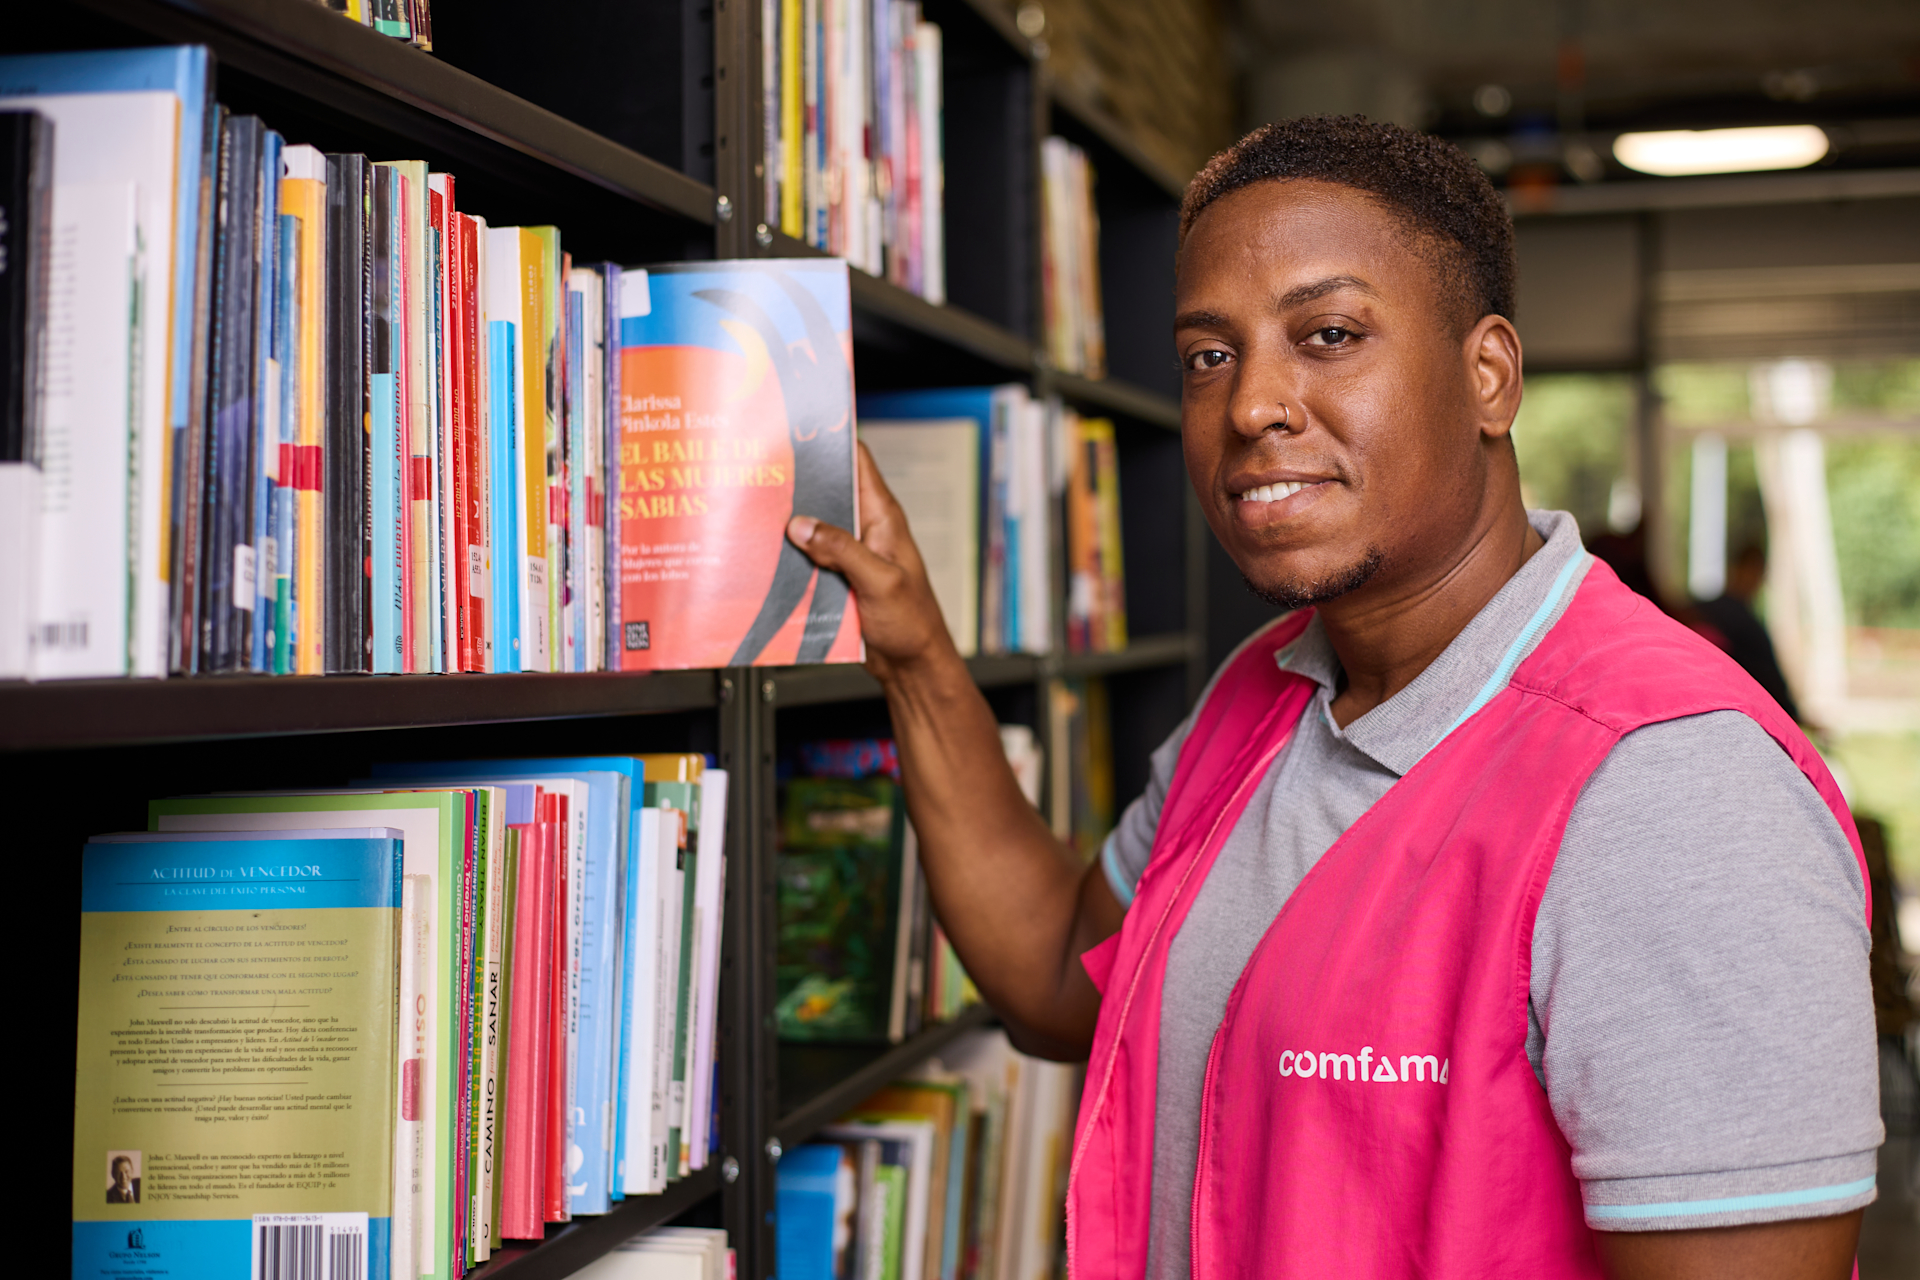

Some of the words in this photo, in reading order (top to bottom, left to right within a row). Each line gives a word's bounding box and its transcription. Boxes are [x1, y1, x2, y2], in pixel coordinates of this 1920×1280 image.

[393, 258, 401, 324] WALTER
[455, 447, 460, 461] EN
[621, 442, 649, 466] EL
[652, 439, 727, 464] BAILE
[733, 437, 768, 460] DE
[621, 467, 666, 493] LAS
[668, 463, 786, 490] MUJERES
[621, 494, 709, 520] SABIAS
[641, 543, 651, 555] la
[652, 544, 686, 555] autora
[621, 572, 642, 584] con
[644, 571, 659, 582] los
[661, 570, 689, 582] lobos
[576, 811, 584, 862] Flags
[150, 867, 216, 879] ACTITUD
[220, 869, 236, 878] DE
[240, 865, 323, 878] VENCEDOR
[164, 888, 176, 896] LA
[178, 888, 207, 896] CLAVE
[210, 887, 228, 895] DEL
[230, 886, 258, 895] ÉXITO
[260, 886, 307, 894] PERSONAL
[203, 973, 218, 981] QUE
[475, 957, 484, 984] LAS
[210, 988, 260, 996] TRANSFORMAR
[474, 993, 483, 1038] LEYES
[489, 972, 498, 1046] SANAR
[416, 993, 426, 1057] OSH
[468, 1037, 473, 1051] LA
[468, 1055, 473, 1071] DE
[473, 1048, 481, 1065] DE
[473, 1074, 480, 1090] LA
[471, 1100, 480, 1158] SUERTE
[485, 1078, 494, 1174] CAMINO
